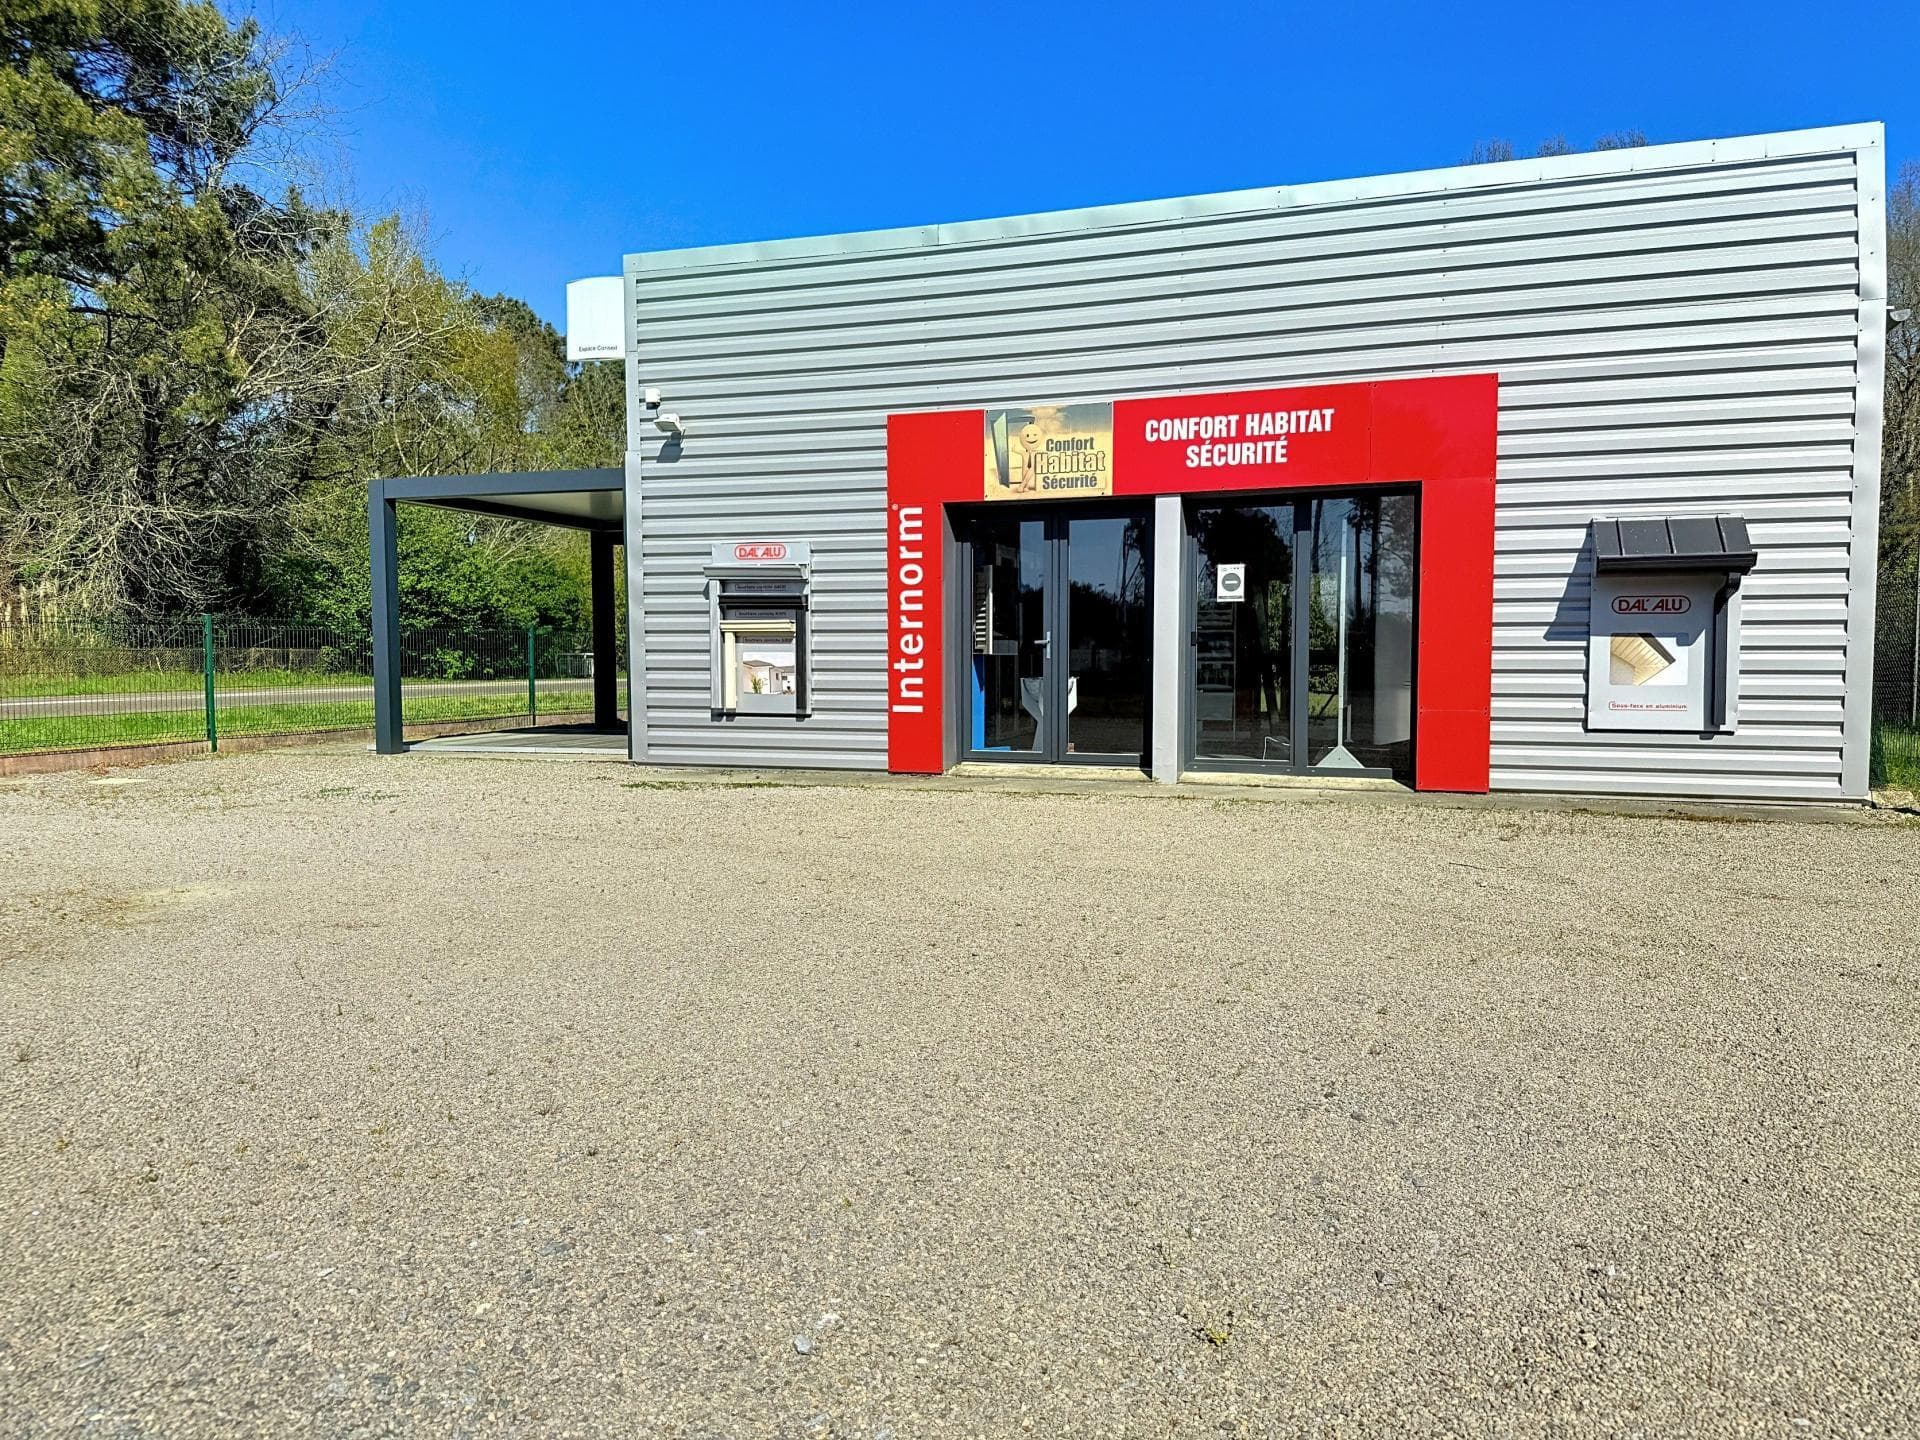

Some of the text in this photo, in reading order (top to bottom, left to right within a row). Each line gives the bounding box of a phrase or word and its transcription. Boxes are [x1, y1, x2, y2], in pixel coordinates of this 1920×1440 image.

[1145, 408, 1335, 442] CONFORT HABITAT
[1045, 437, 1095, 452] Confort
[1185, 435, 1288, 468] SÉCURITÉ
[1034, 450, 1106, 475] Habitat
[1042, 473, 1098, 490] Sécurité
[761, 547, 781, 557] ALU
[1651, 598, 1683, 611] ALU
